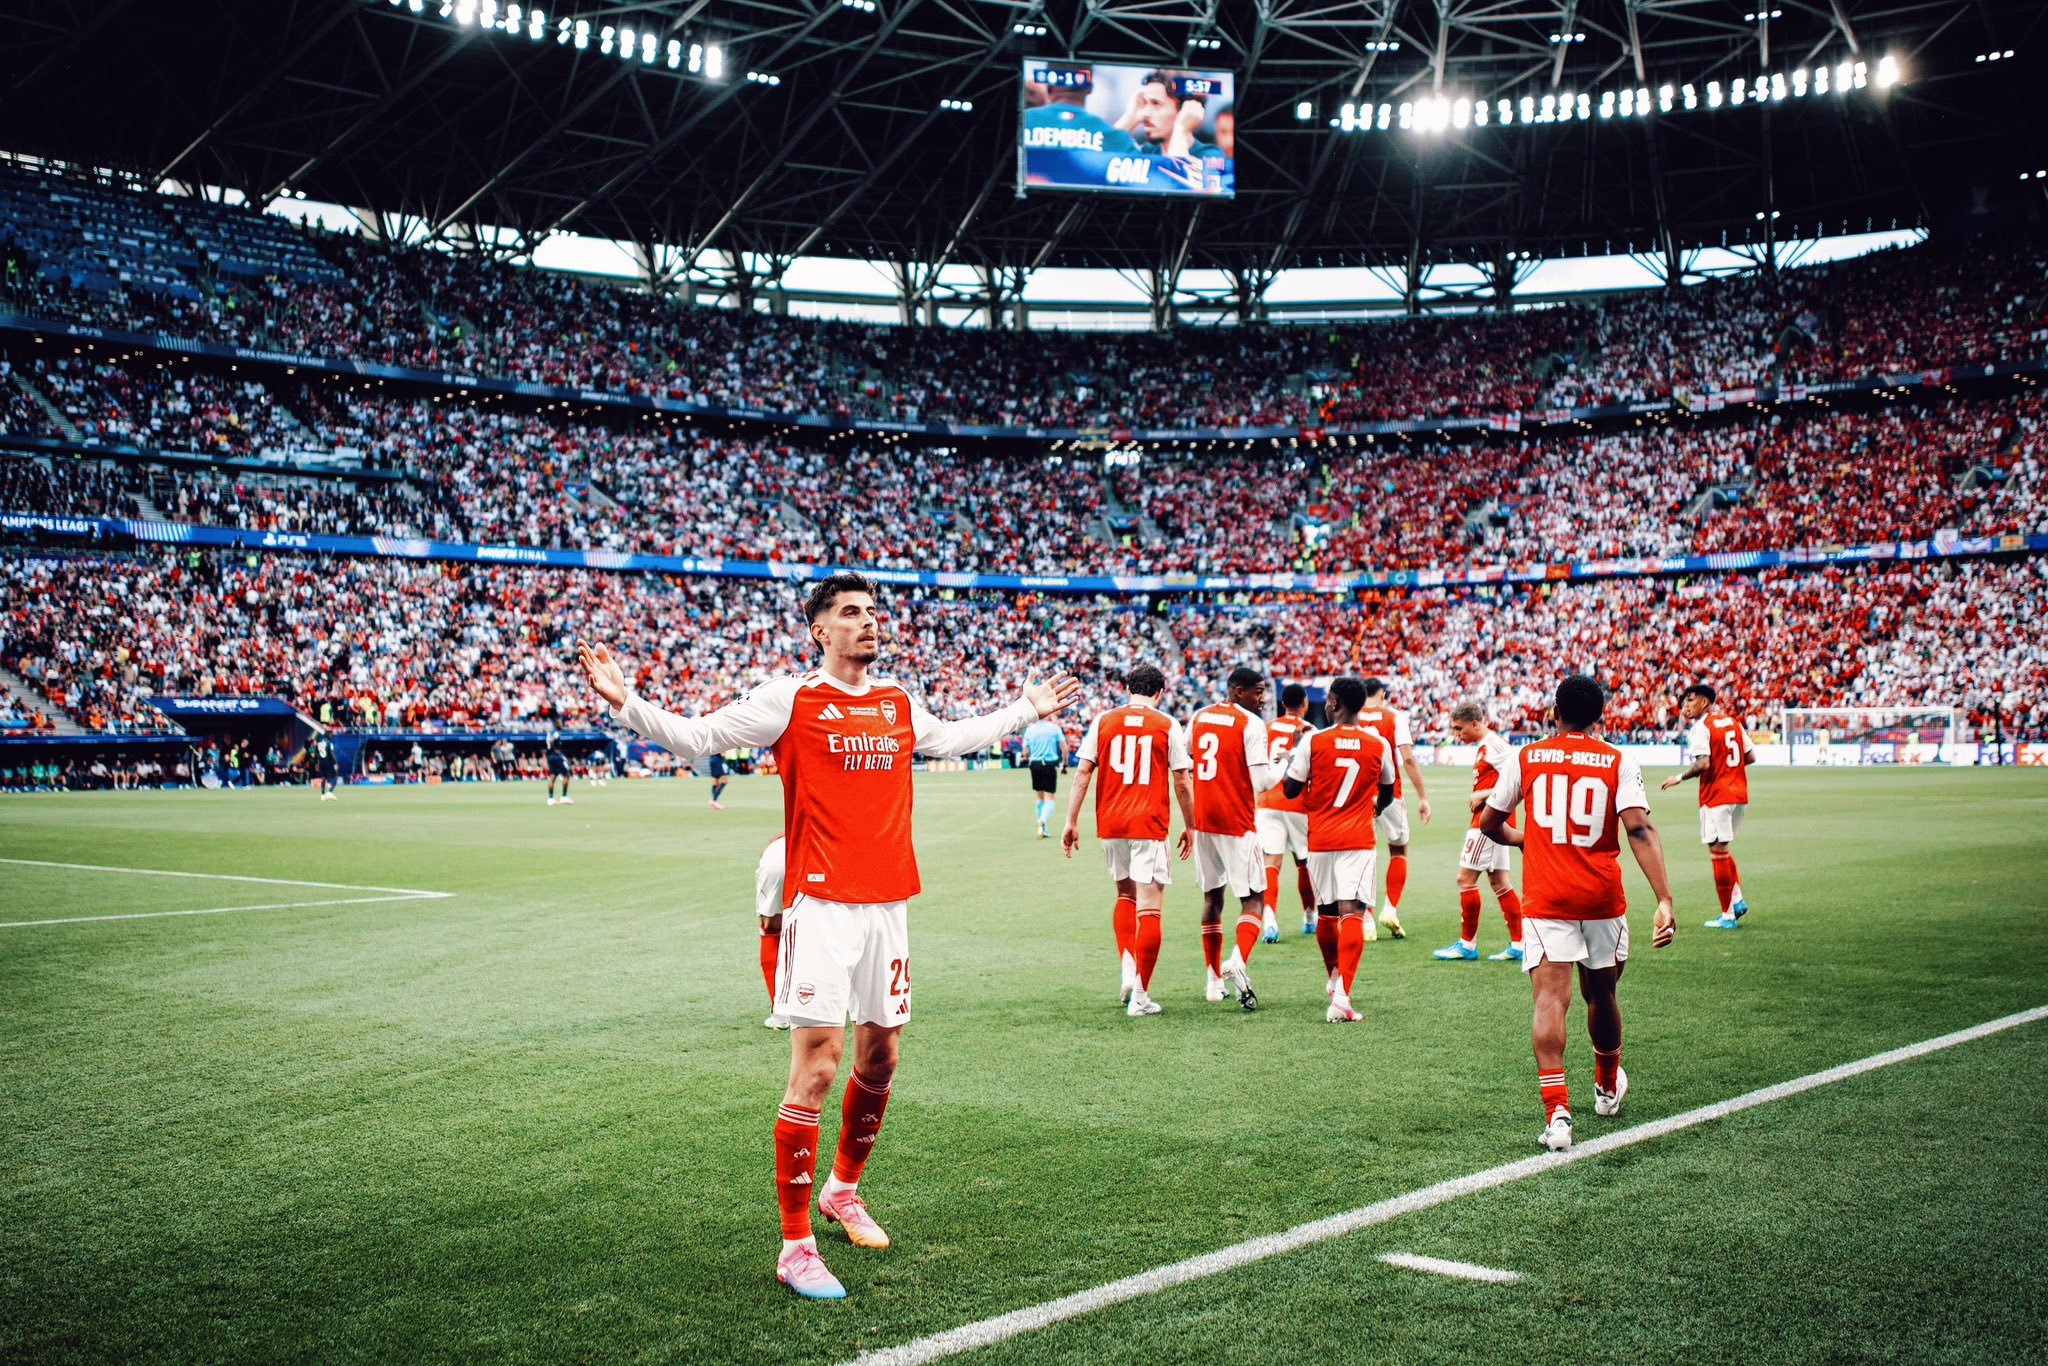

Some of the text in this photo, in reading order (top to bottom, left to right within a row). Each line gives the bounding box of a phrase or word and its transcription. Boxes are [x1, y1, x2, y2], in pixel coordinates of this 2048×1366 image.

[1106, 157, 1150, 184] GOAL
[278, 535, 307, 546] PS5
[518, 548, 547, 561] FINAL
[827, 732, 900, 753] Emirates
[1334, 738, 1362, 751] SAKA
[1724, 730, 1741, 768] 5
[844, 754, 863, 770] FLY
[864, 754, 894, 770] BETTER
[1109, 733, 1154, 785] 41
[1197, 732, 1220, 781] 3
[1527, 749, 1616, 768] LEWIS-SKELLY
[1335, 757, 1361, 808] 7
[1532, 773, 1609, 848] 49
